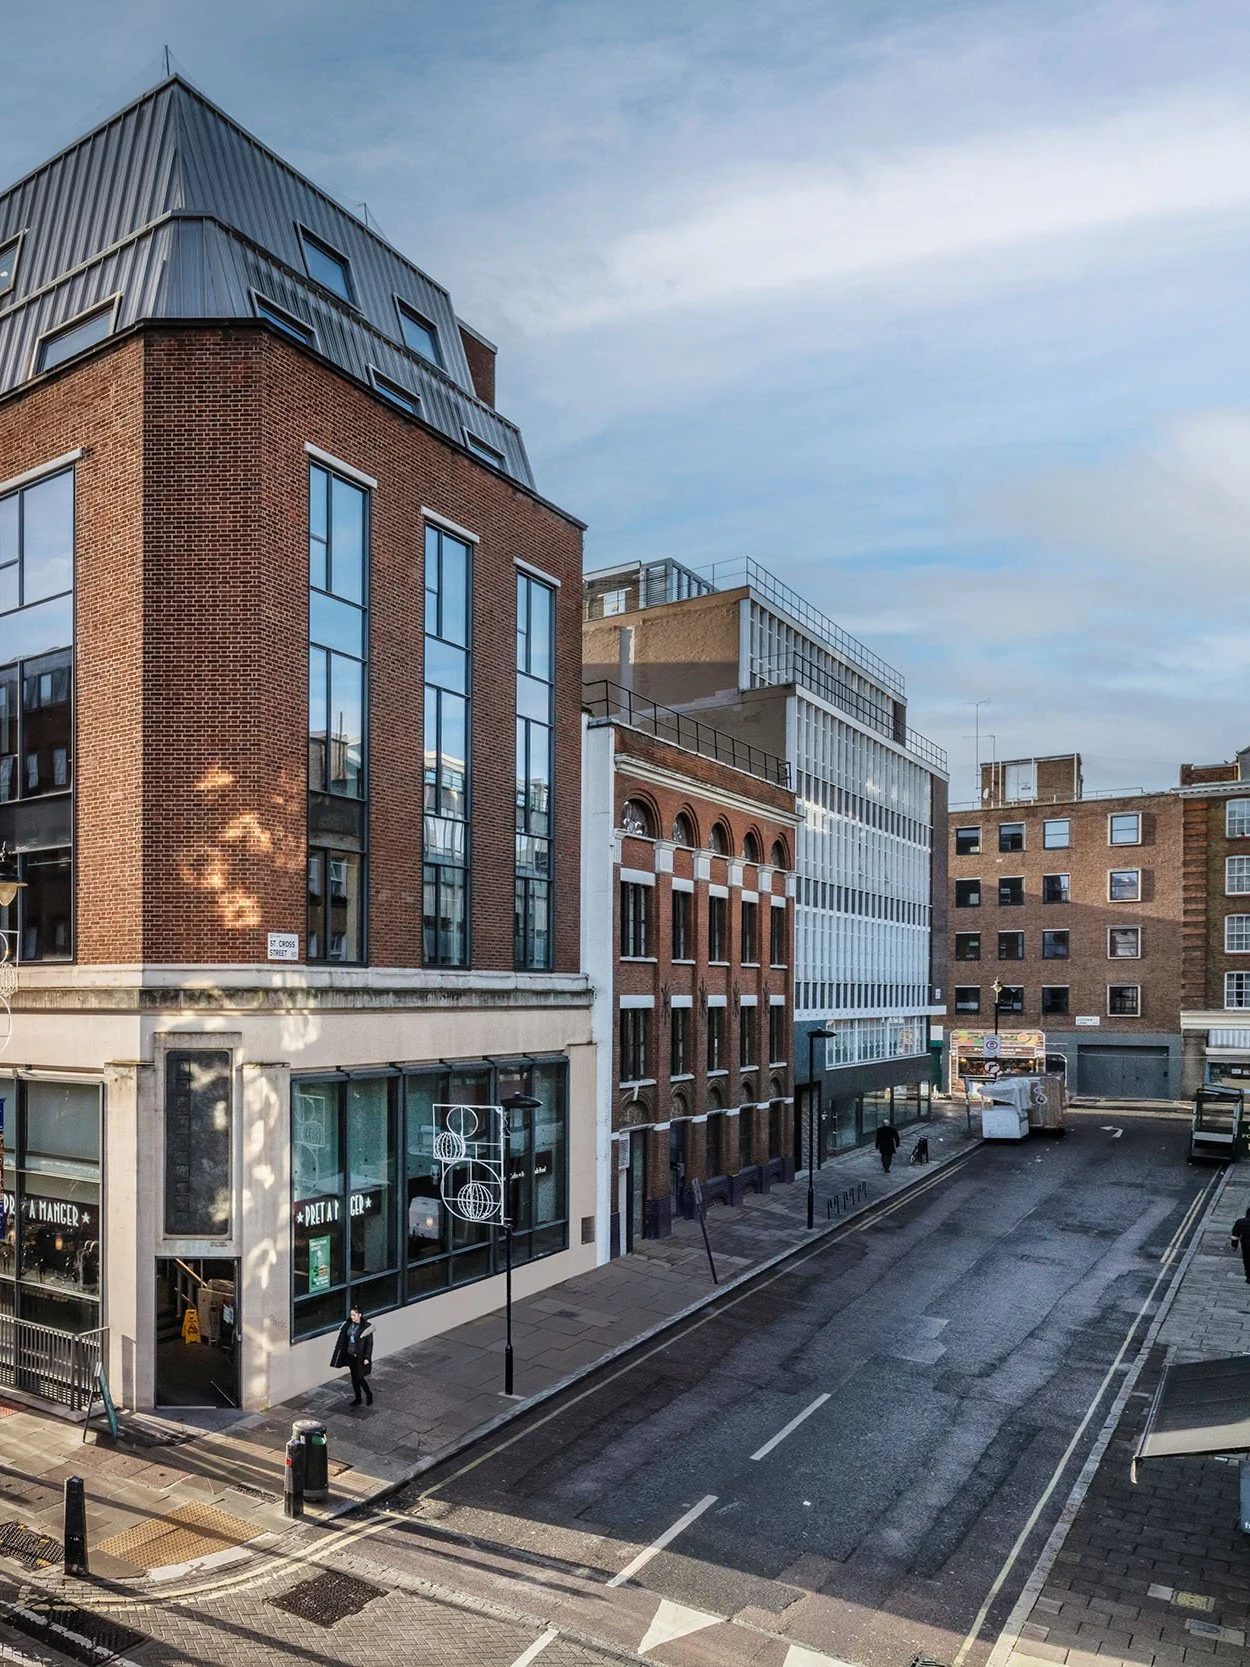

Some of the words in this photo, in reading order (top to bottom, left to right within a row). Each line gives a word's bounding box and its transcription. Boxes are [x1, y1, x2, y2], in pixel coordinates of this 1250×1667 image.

[278, 940, 296, 948] CROSS
[269, 949, 288, 957] STREET
[29, 1200, 36, 1219] A
[39, 1200, 79, 1227] MANGER
[305, 1202, 325, 1227] PRET
[326, 1201, 333, 1222] A
